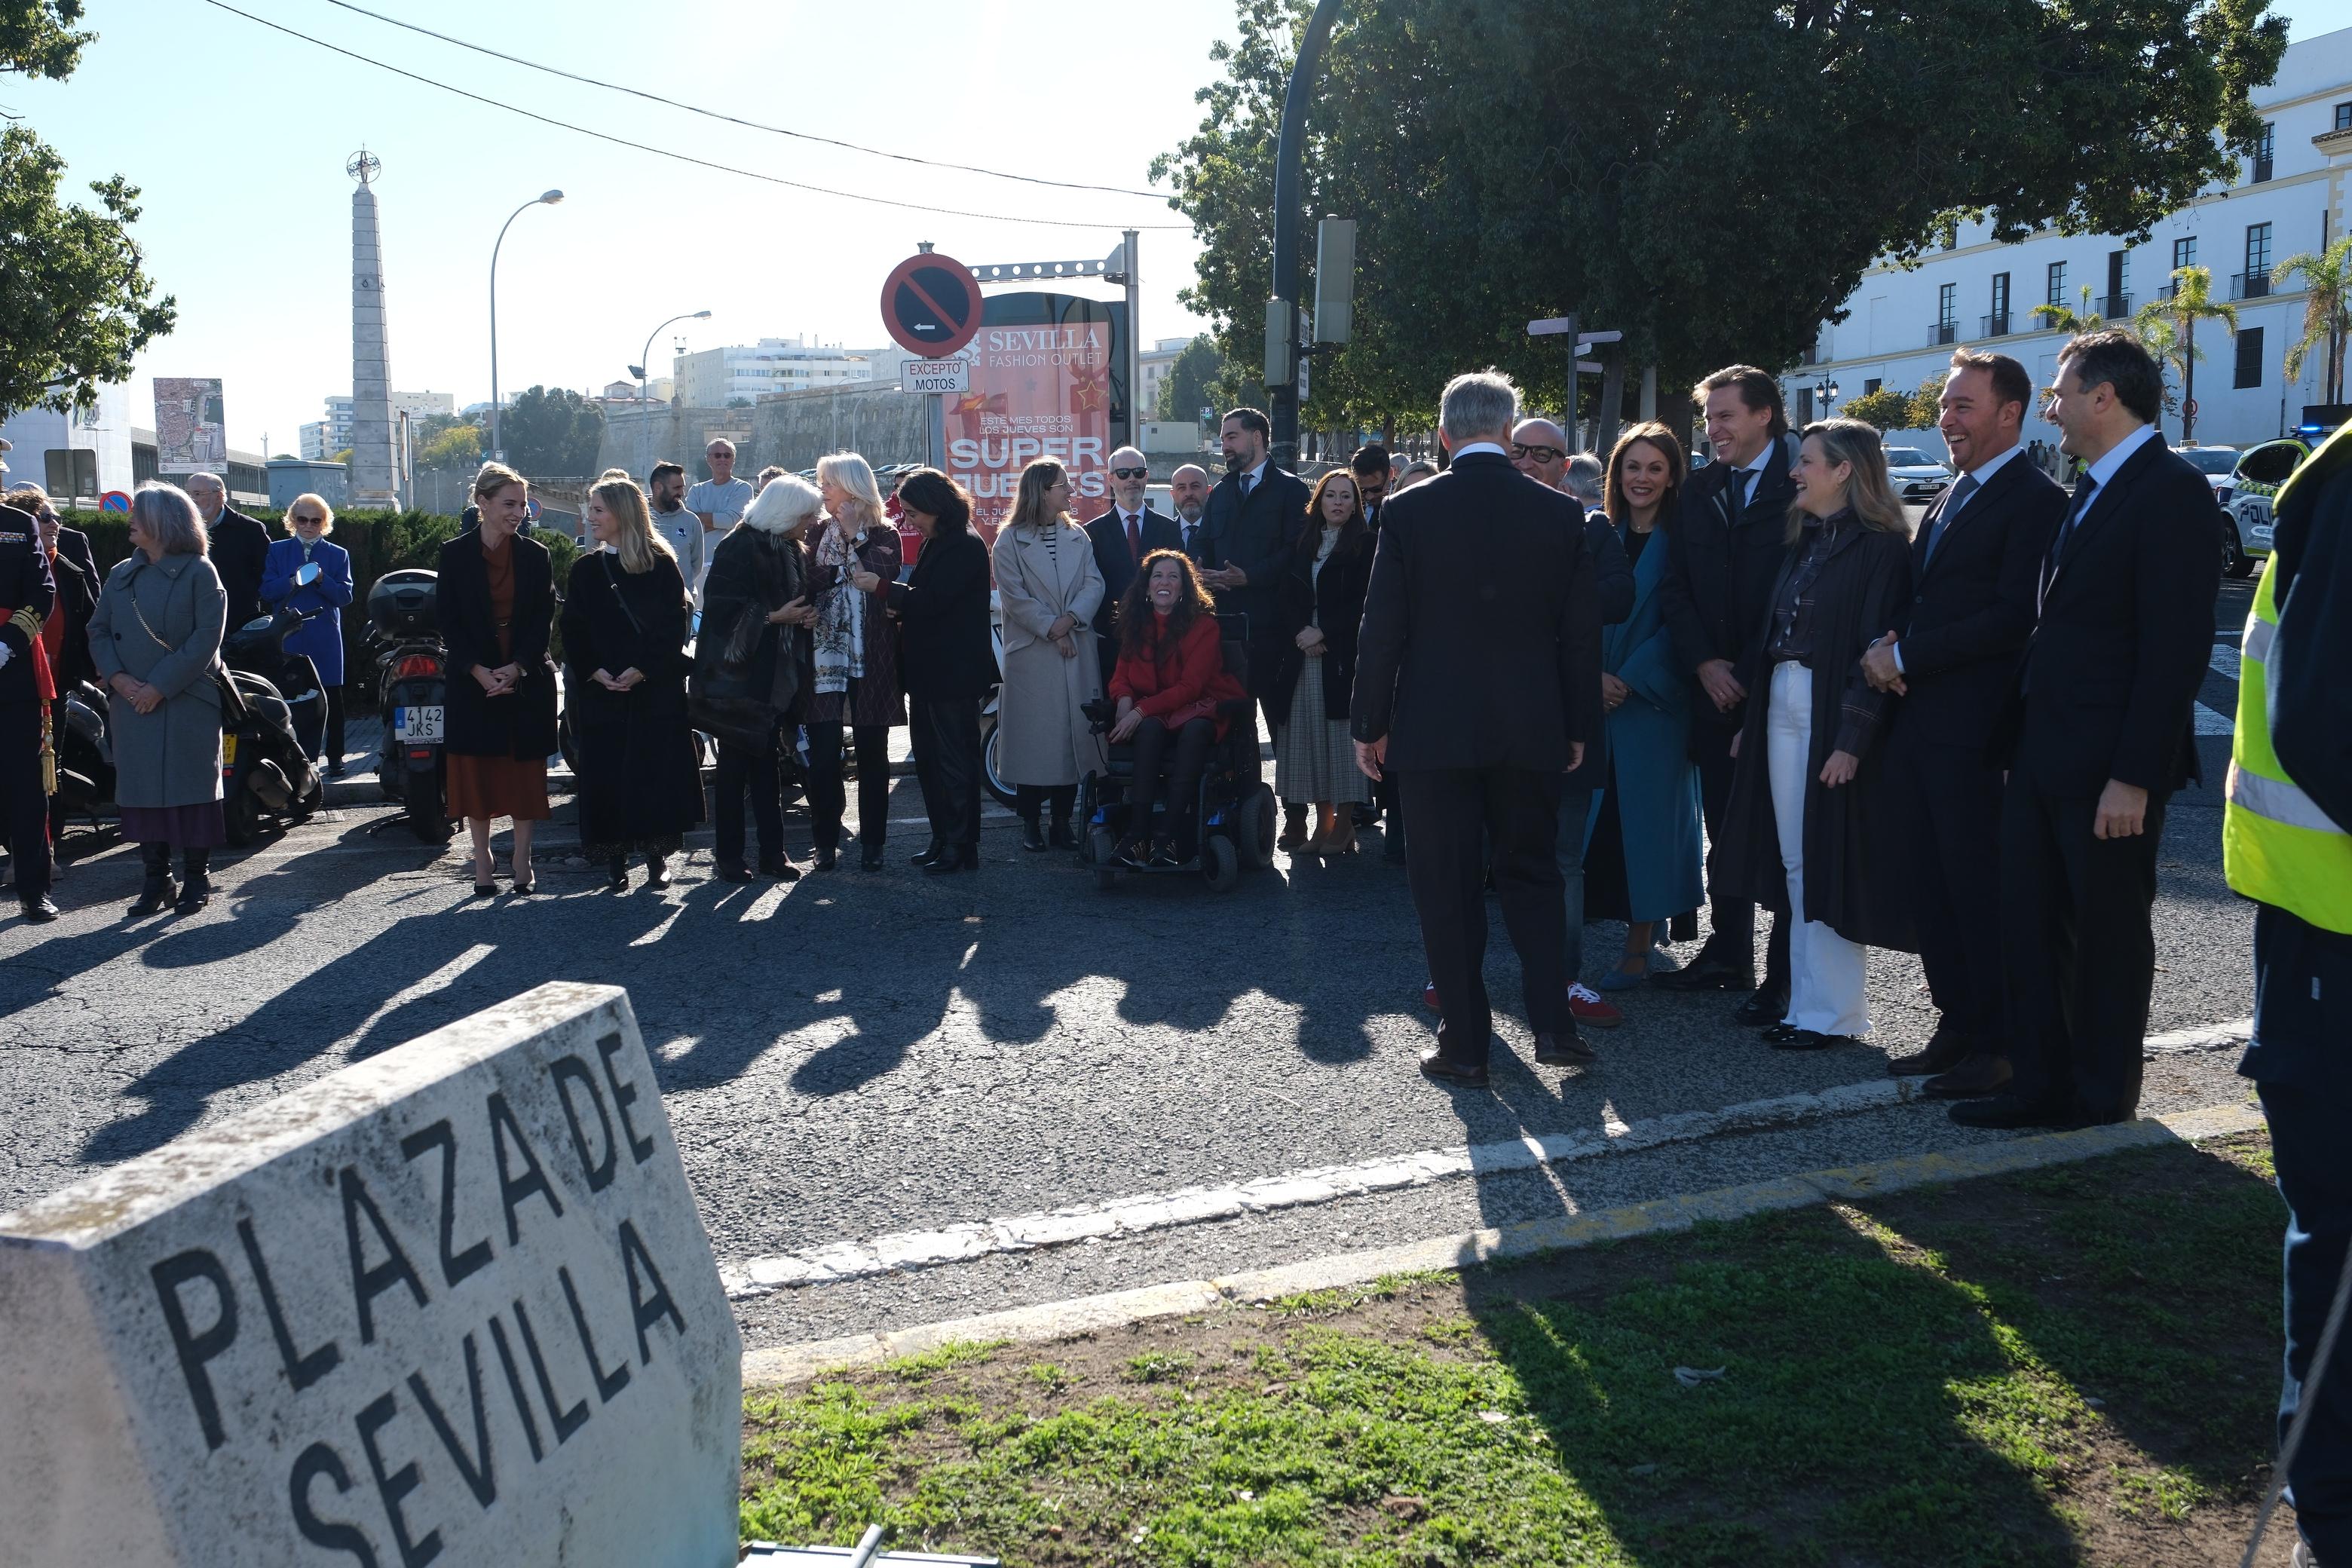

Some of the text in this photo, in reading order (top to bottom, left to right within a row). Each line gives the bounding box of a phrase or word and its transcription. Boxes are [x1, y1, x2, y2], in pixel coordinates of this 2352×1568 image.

[989, 328, 1102, 352] SEVILLA
[989, 351, 1102, 367] FASHION OUTLET
[909, 363, 960, 375] EXCEPTO
[915, 378, 955, 390] MOTOS
[981, 415, 1071, 425] ESTE MES TODOS
[979, 424, 1073, 434] LOS JUEVES SON
[950, 436, 1103, 469] SUPER
[952, 471, 1105, 498] JUES
[975, 508, 989, 516] EL
[2240, 503, 2272, 526] POLI
[982, 517, 989, 525] Y
[407, 723, 433, 737] JKS
[150, 1031, 655, 1451] PLAZA DE
[289, 1218, 688, 1568] SEVILLA
